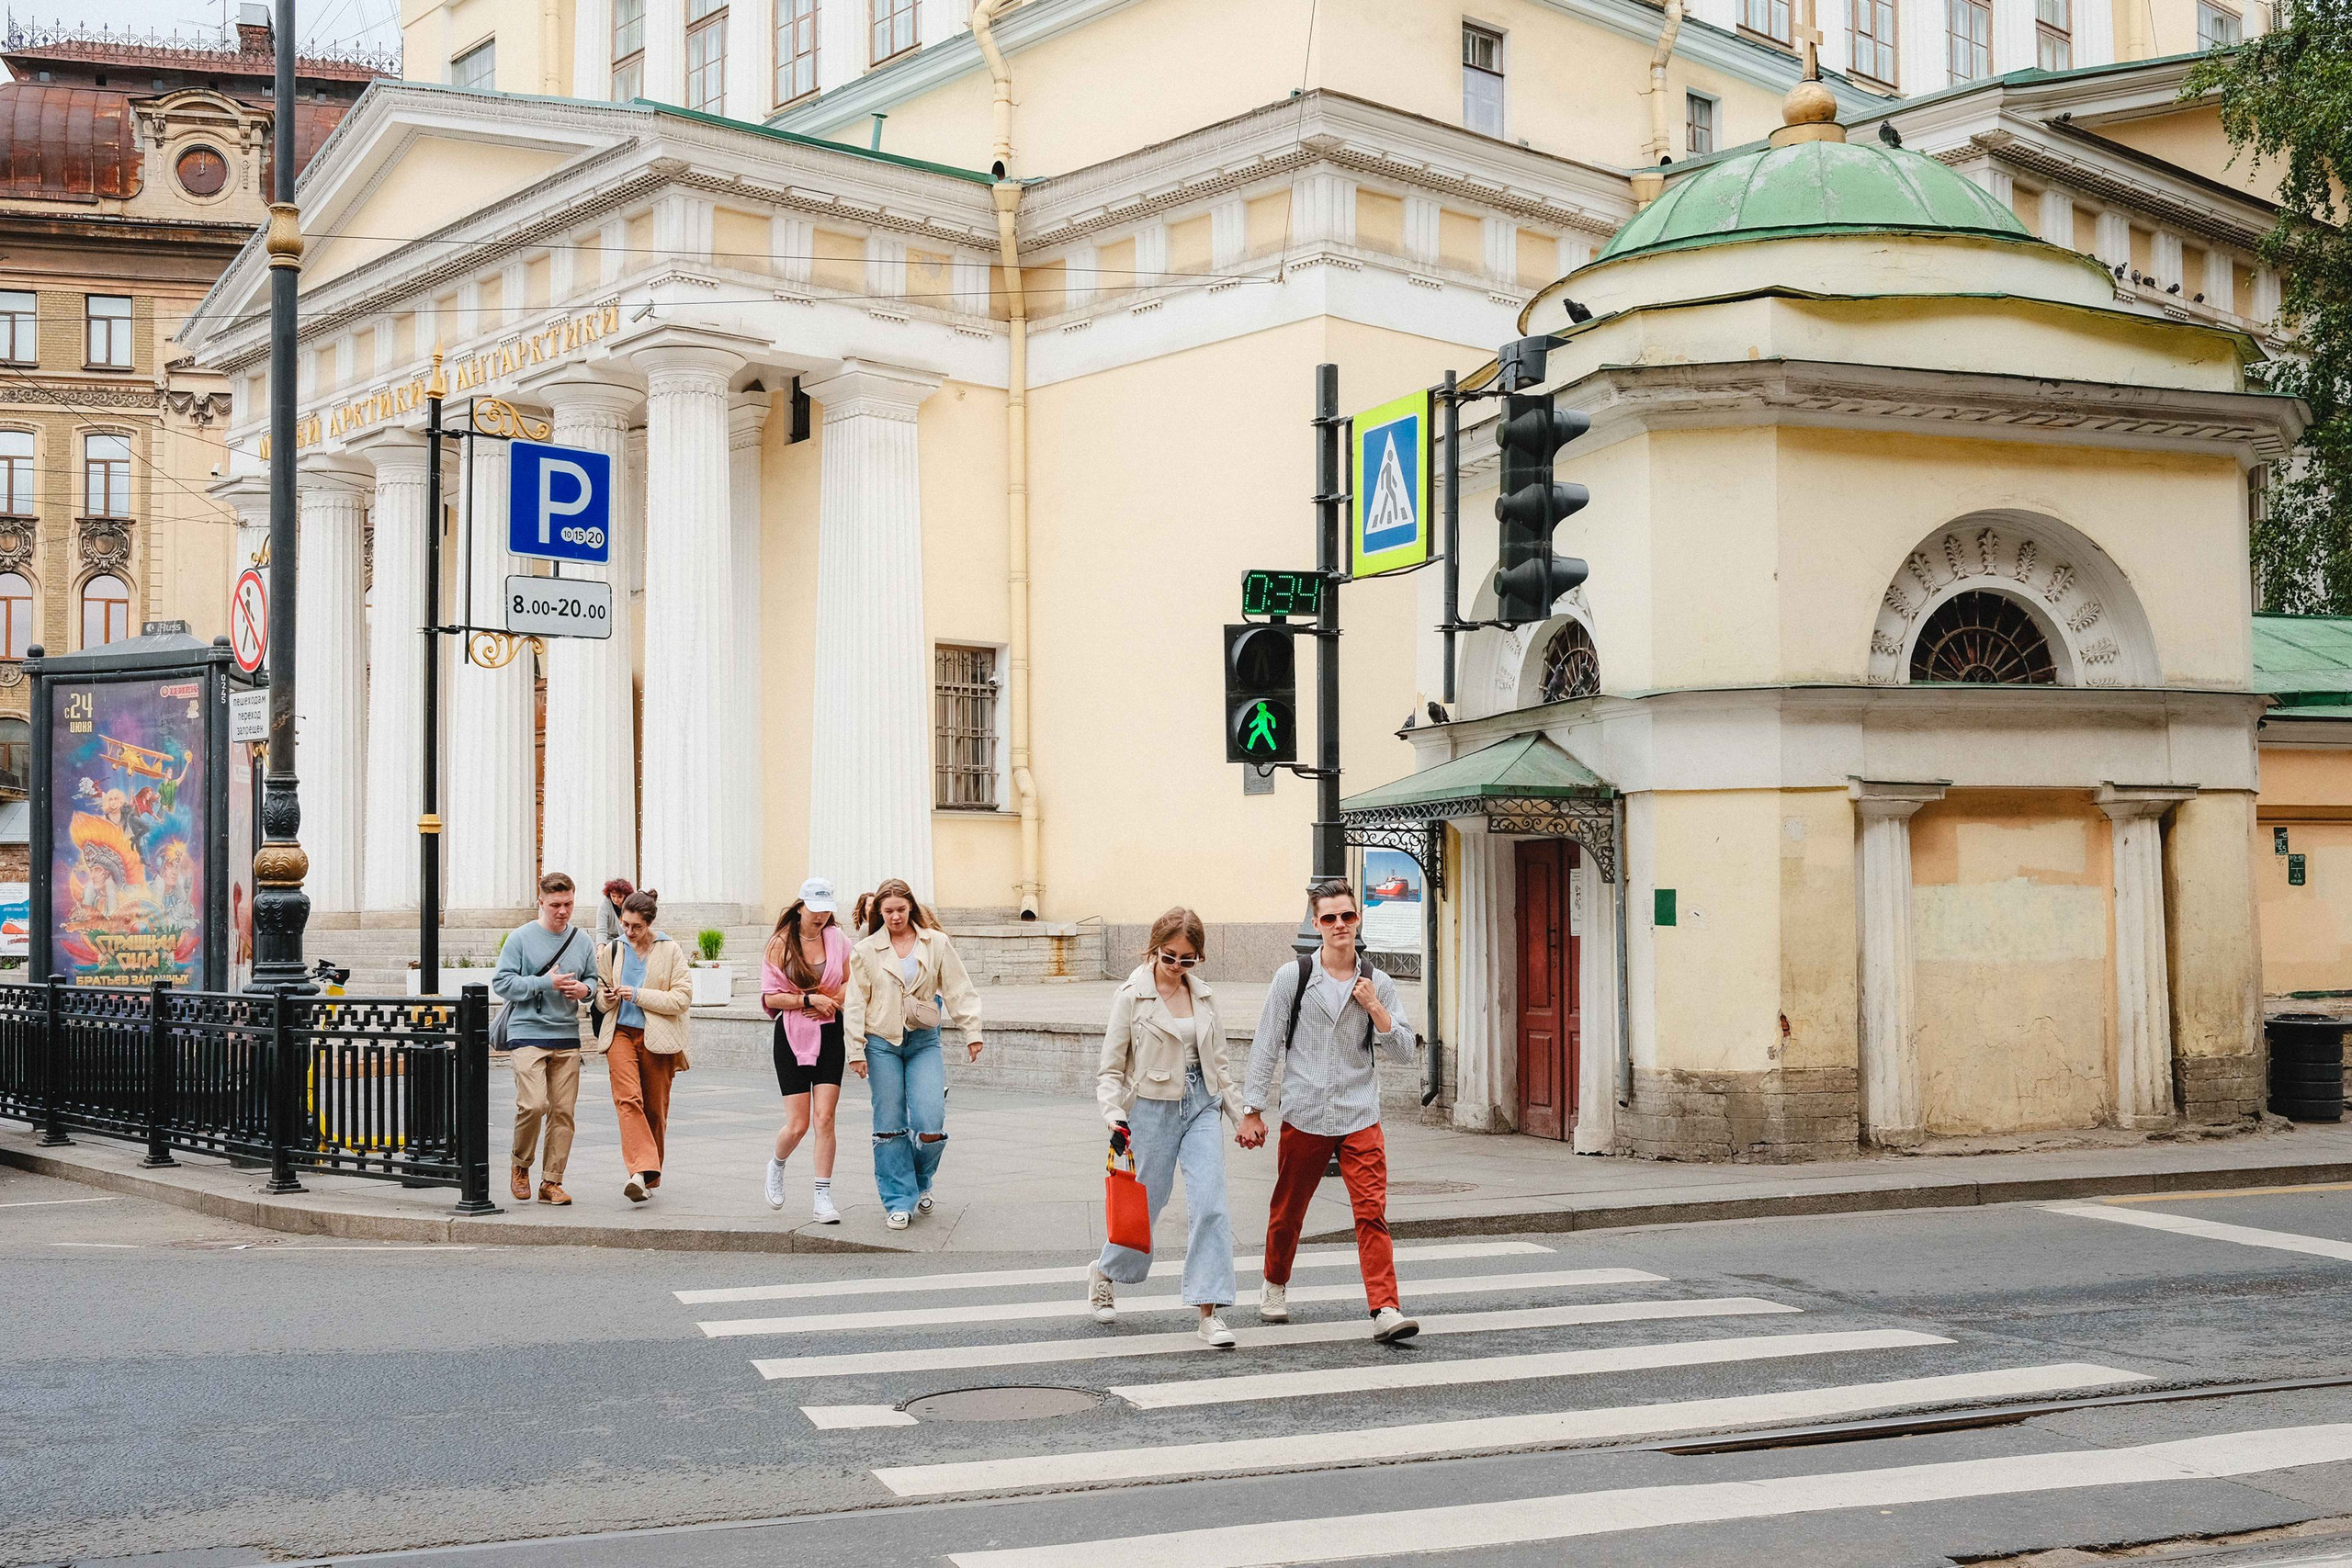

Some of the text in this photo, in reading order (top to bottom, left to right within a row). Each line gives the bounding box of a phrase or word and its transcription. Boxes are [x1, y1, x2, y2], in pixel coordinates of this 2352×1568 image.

[259, 411, 322, 461] МЕЙ
[329, 378, 425, 438] АРКТИКИ
[456, 304, 618, 392] АНТАРКТИКИ
[537, 457, 593, 544] P
[563, 530, 603, 544] 10 15 20
[1245, 574, 1318, 613] 0:34
[513, 594, 606, 620] 8.00-20.00
[70, 693, 93, 718] 24
[233, 695, 266, 706] пешеходам
[238, 711, 262, 723] переход
[237, 725, 264, 737] запрещен
[116, 952, 159, 972] СИЛА
[76, 975, 130, 986] БРАТЬЕВ
